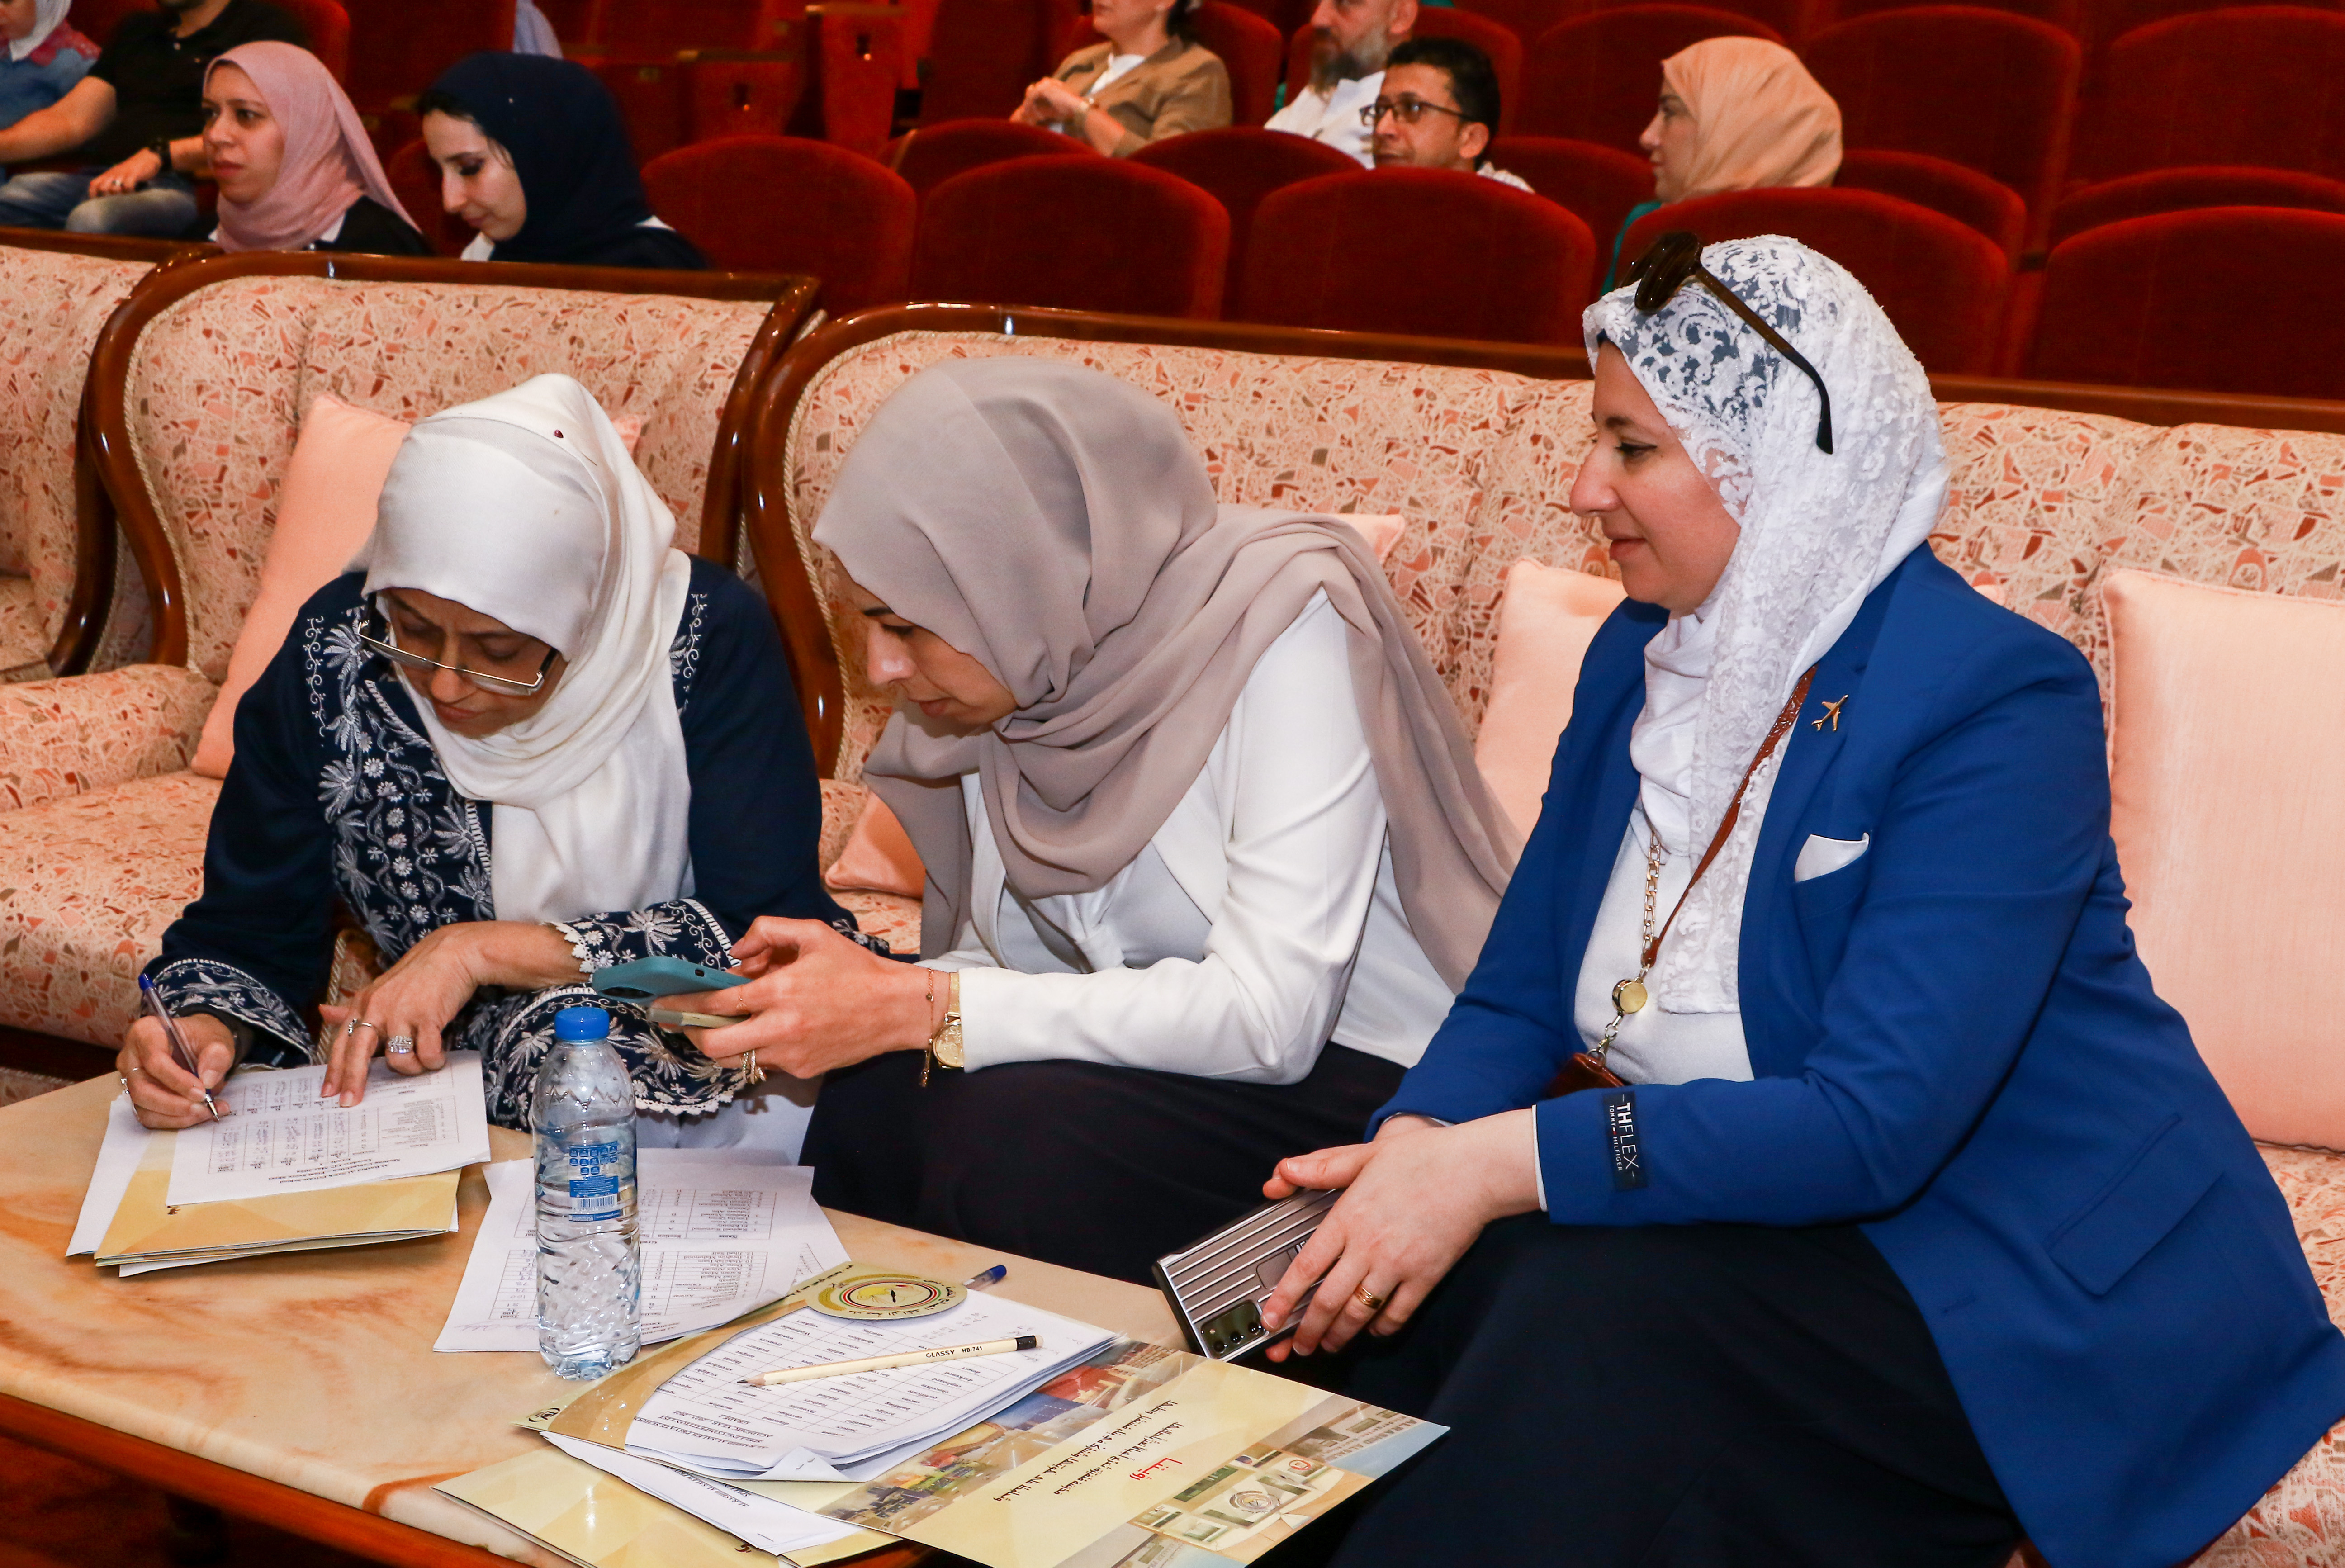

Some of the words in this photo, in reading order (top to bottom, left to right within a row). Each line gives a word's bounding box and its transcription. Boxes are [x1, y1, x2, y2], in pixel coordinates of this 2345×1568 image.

[1613, 1137, 1623, 1172] HILFIGER
[925, 1350, 955, 1358] CLASSY
[932, 1378, 962, 1388] cupboard
[920, 1384, 949, 1393] chocolate
[907, 1390, 938, 1399] certificate
[885, 1402, 911, 1411] building
[723, 1415, 750, 1425] GRADE
[844, 1420, 873, 1428] beautiful
[660, 1424, 694, 1436] PRIVATE
[675, 1419, 725, 1437] COMPETITION
[732, 1426, 771, 1438] ACADEMIC
[726, 1432, 762, 1444] SPELLING
[1129, 1458, 1183, 1481] رؤيتنا
